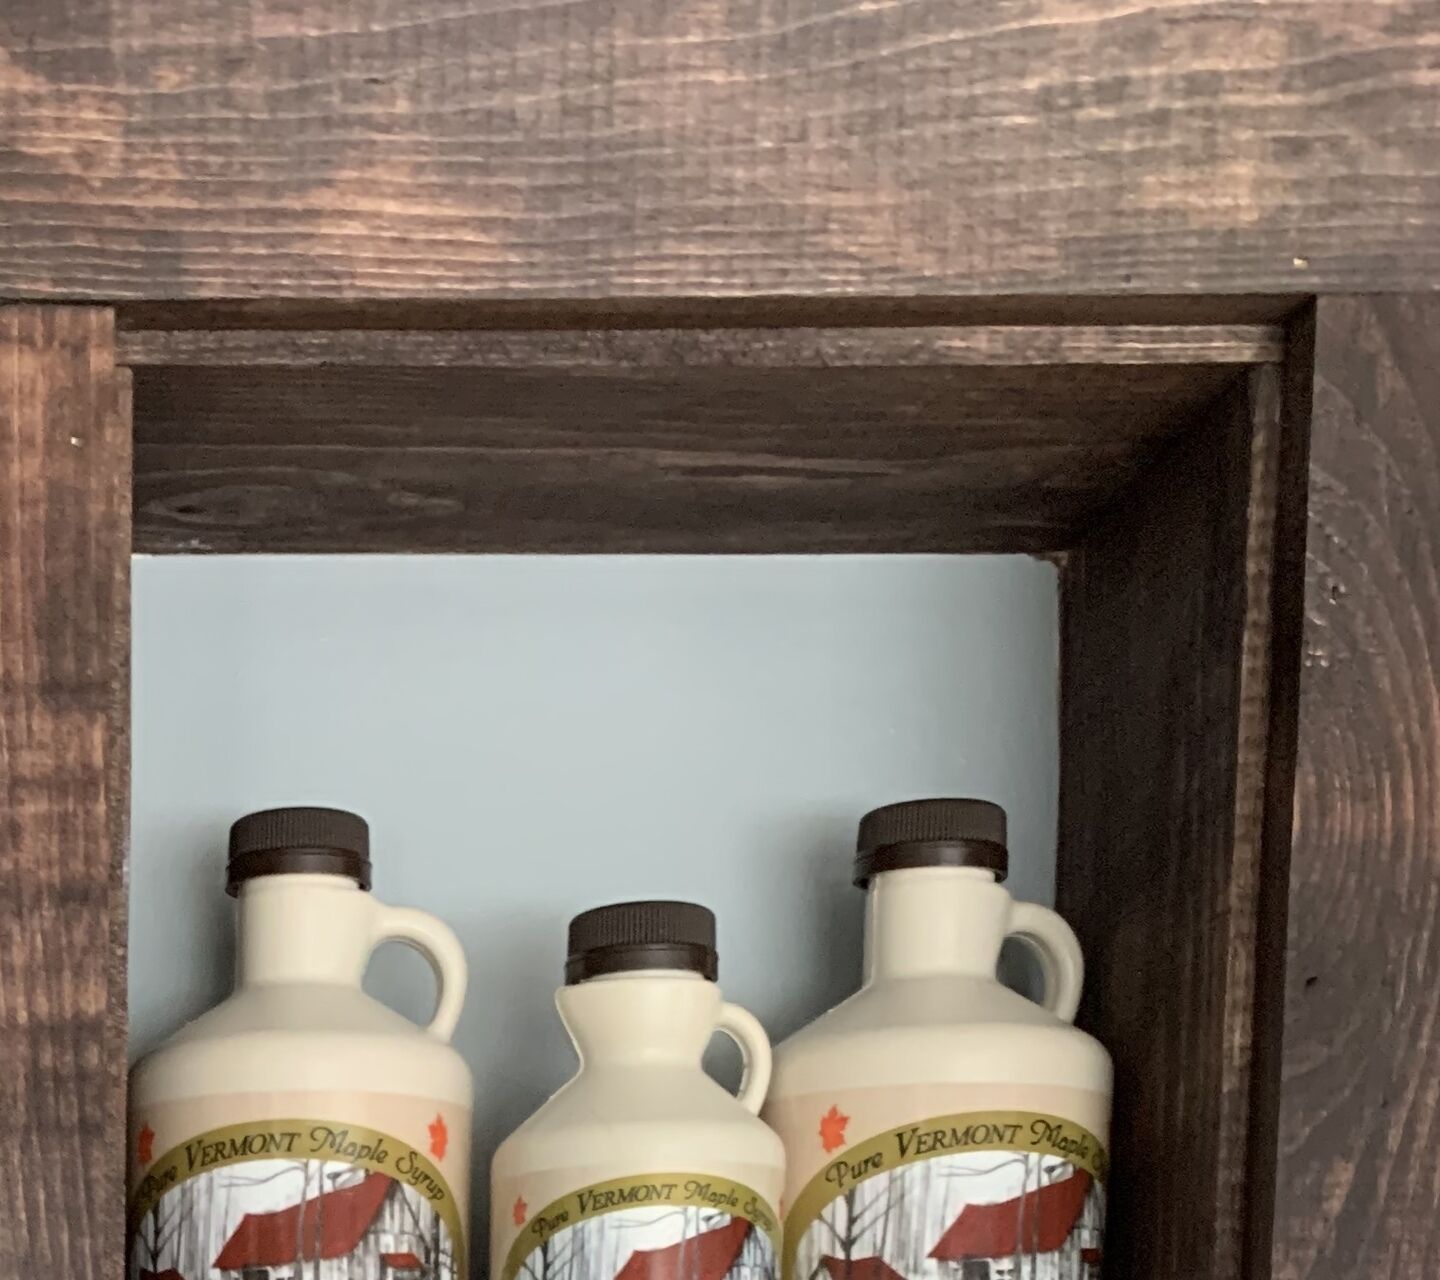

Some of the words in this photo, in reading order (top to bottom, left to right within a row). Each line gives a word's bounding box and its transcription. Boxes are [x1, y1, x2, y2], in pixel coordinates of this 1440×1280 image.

[185, 1132, 302, 1172] VERMONT
[310, 1127, 388, 1164] Maple
[396, 1150, 445, 1201] Syrup
[826, 1152, 883, 1188] Pure
[896, 1124, 1023, 1159] VERMONT
[1030, 1120, 1088, 1160] Maple
[531, 1209, 569, 1238] Pure
[577, 1183, 677, 1214] VERMONT
[683, 1180, 739, 1214] Maple
